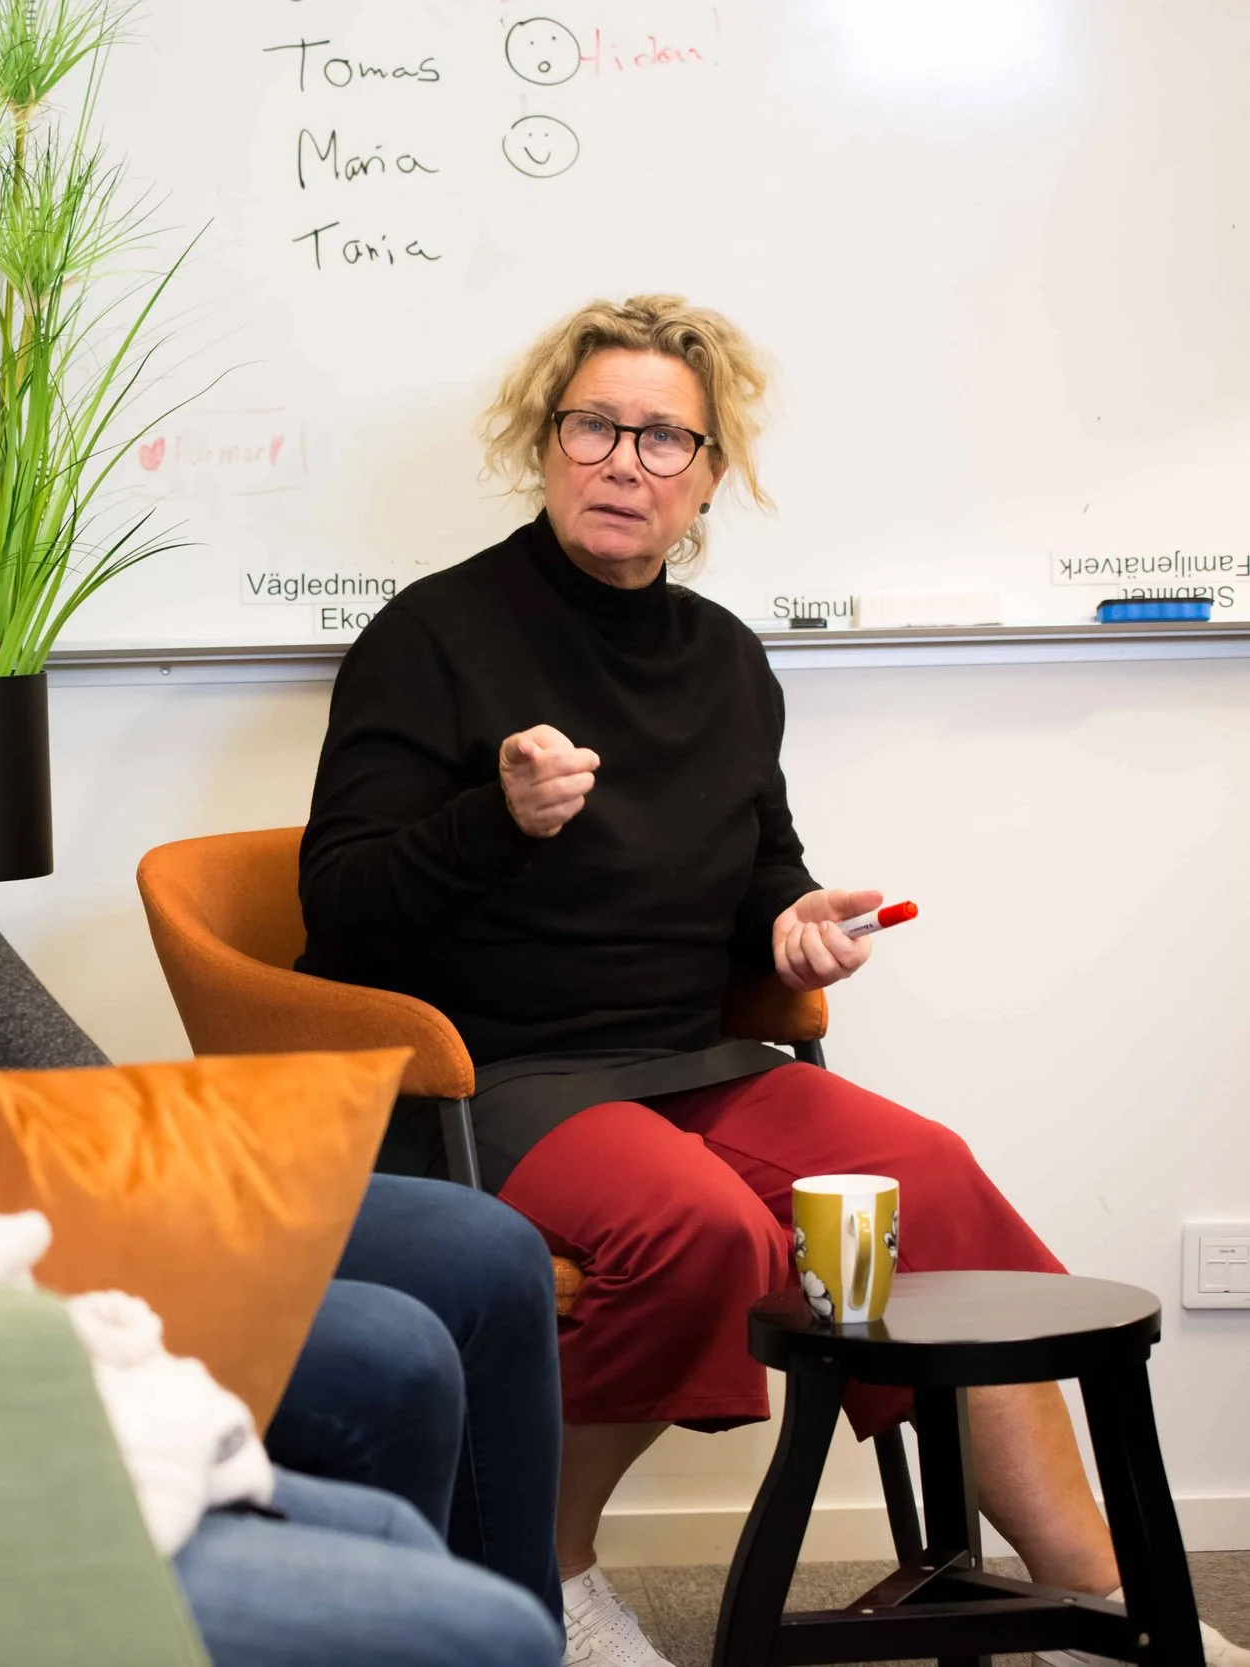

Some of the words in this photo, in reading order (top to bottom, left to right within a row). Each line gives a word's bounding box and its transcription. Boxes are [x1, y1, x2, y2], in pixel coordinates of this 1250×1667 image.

[263, 38, 440, 92] Tomas
[297, 128, 440, 190] Maria
[292, 221, 442, 270] Tania
[1059, 550, 1250, 580] Familjenätverk
[246, 573, 397, 602] Vägledning
[321, 608, 378, 630] Eko
